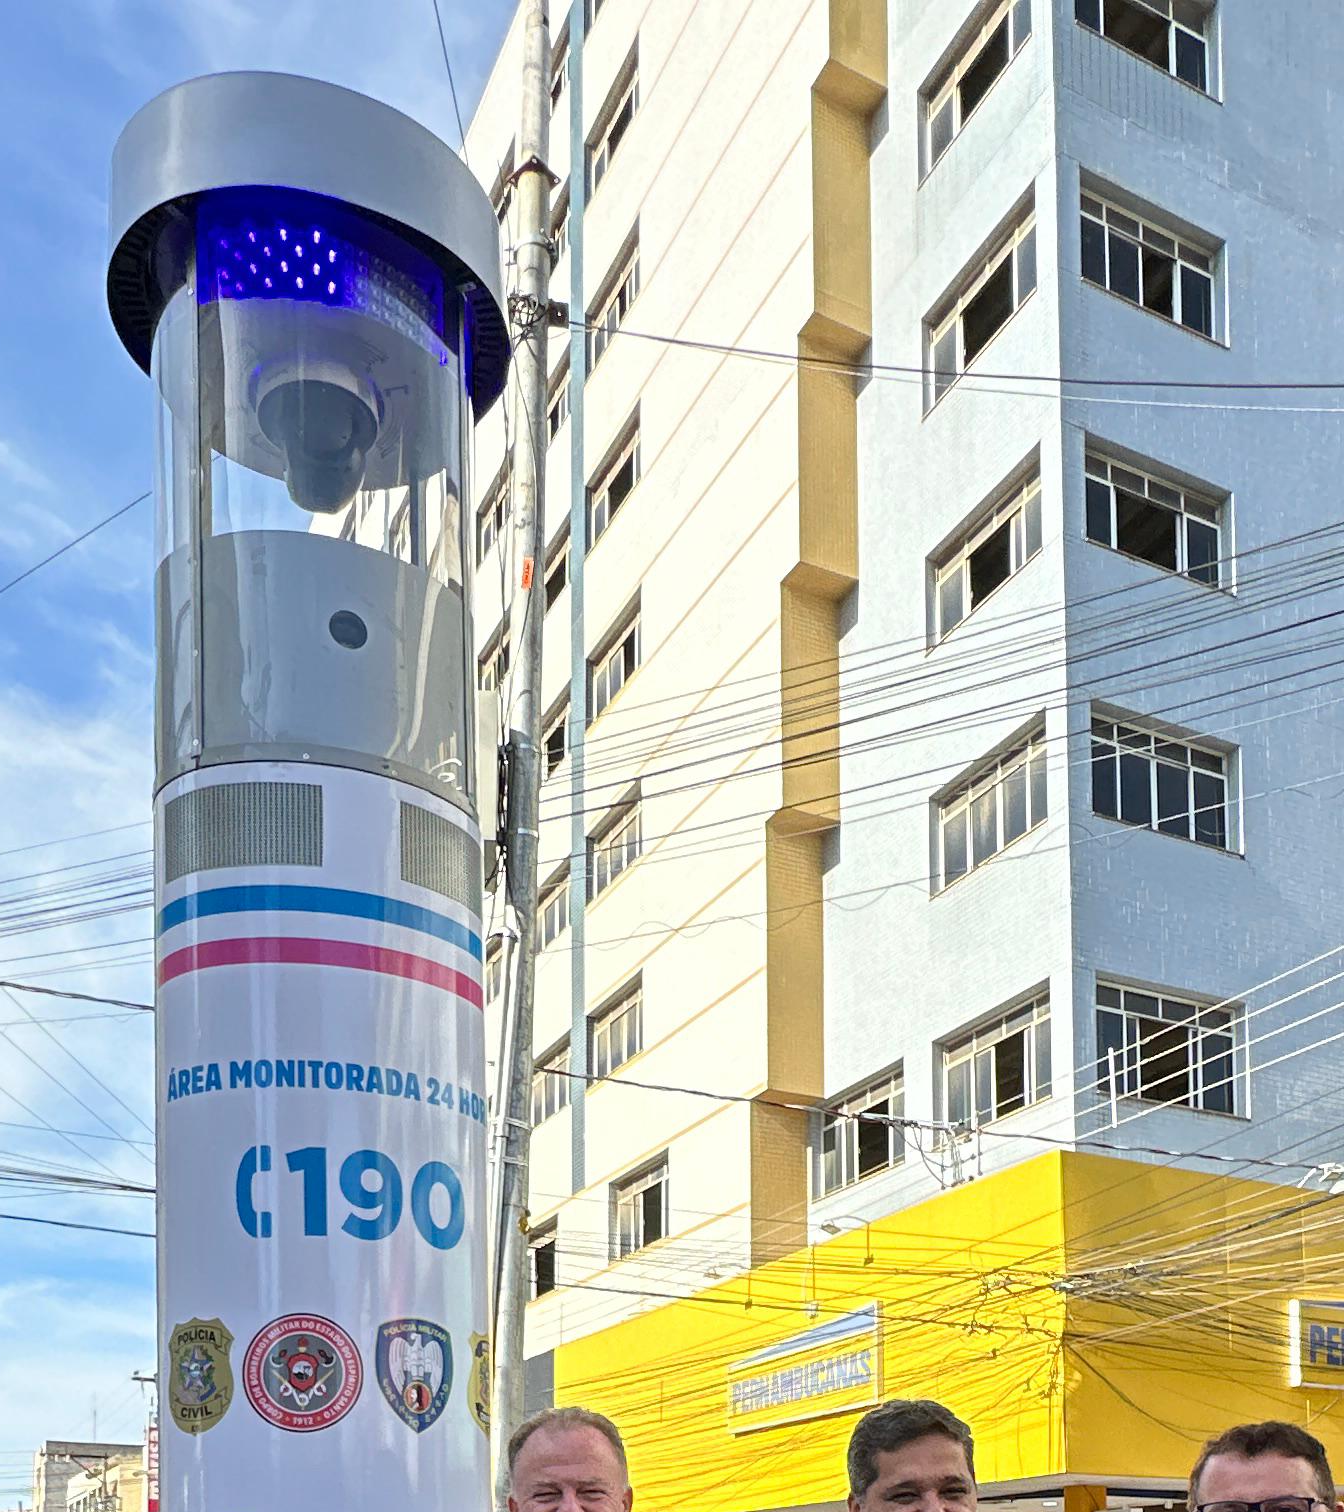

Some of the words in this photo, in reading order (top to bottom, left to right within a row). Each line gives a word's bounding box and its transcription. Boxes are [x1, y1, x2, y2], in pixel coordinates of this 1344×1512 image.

[167, 1063, 222, 1103] ÁREA
[229, 1059, 421, 1102] MONITORADA
[426, 1076, 455, 1110] 24
[458, 1086, 487, 1127] HOR
[286, 1146, 465, 1251] 190
[180, 1405, 213, 1419] CIVIL
[731, 1349, 872, 1415] PERNAMBUCANAS
